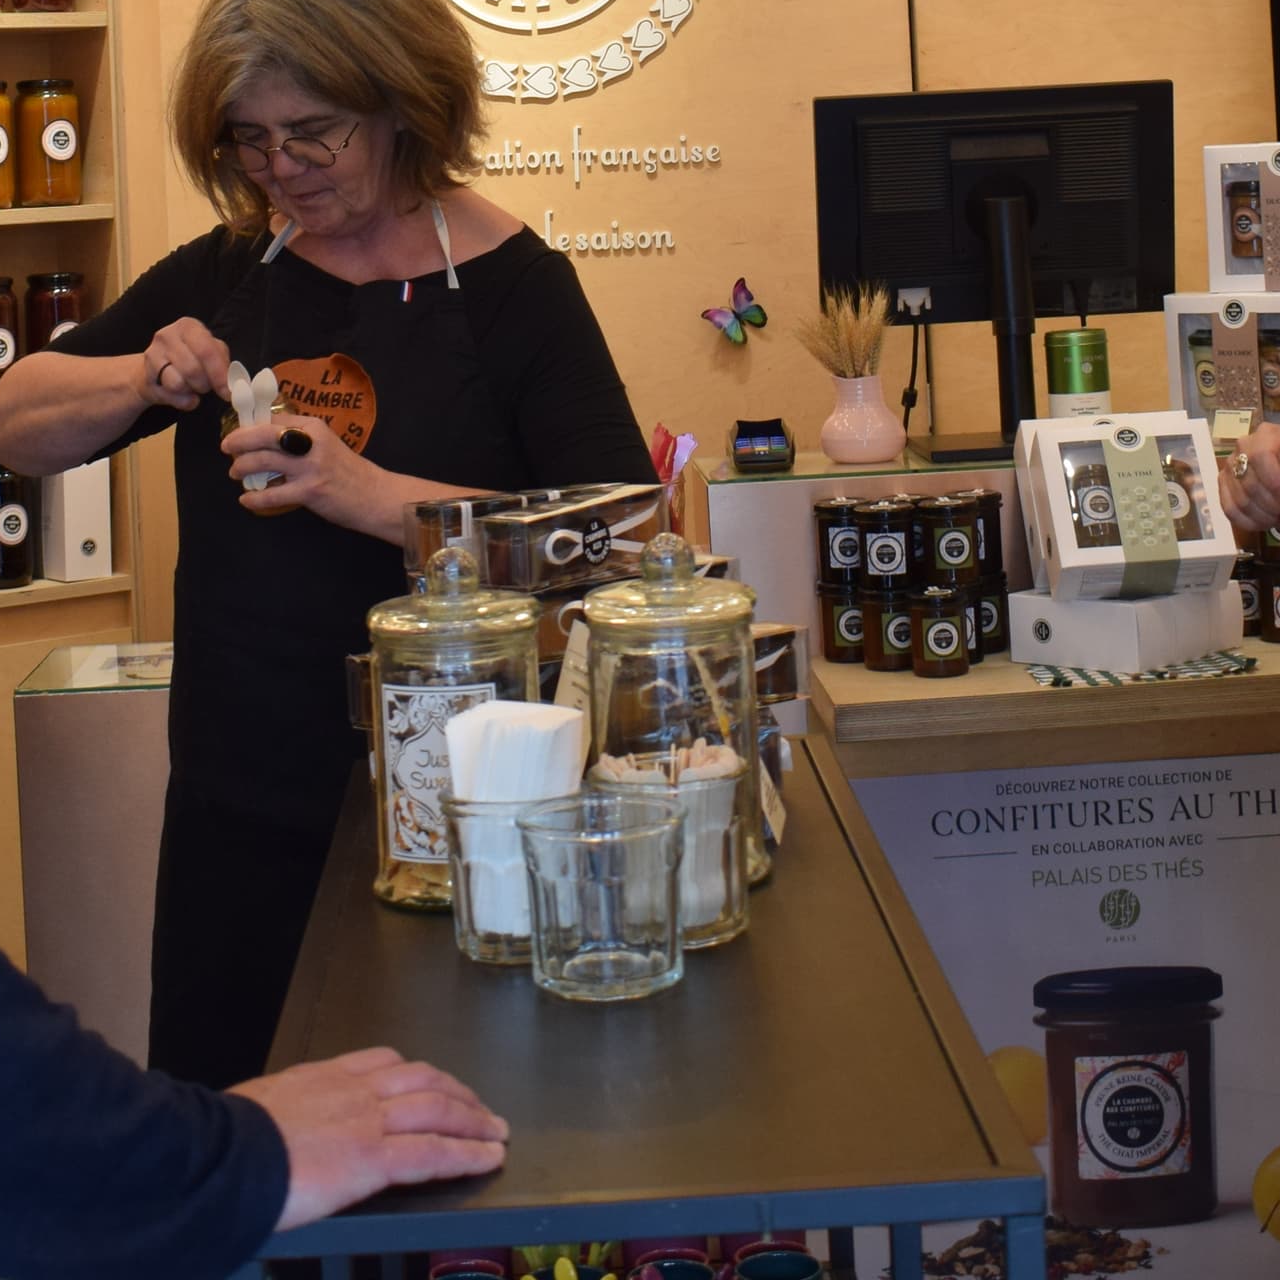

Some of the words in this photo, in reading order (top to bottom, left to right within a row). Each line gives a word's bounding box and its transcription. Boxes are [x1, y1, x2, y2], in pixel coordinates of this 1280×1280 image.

[571, 125, 721, 182] française
[321, 369, 343, 386] LA
[279, 380, 364, 410] CHAMBRE
[415, 749, 450, 768] Jus
[410, 771, 450, 790] Swe
[996, 778, 1076, 796] DÉCOUVREZ
[1079, 776, 1125, 792] NOTRE
[1128, 771, 1212, 787] COLLECTION
[1215, 769, 1233, 782] DE
[931, 797, 1155, 837] CONFITURES
[1169, 793, 1215, 821] AU
[1031, 844, 1050, 857] EN
[1053, 837, 1165, 856] COLLABORATION
[1168, 833, 1204, 847] AVEC
[1031, 866, 1103, 888] PALAIS
[1108, 864, 1148, 882] DES
[1151, 857, 1205, 879] THÉS
[1106, 935, 1138, 943] PARIS
